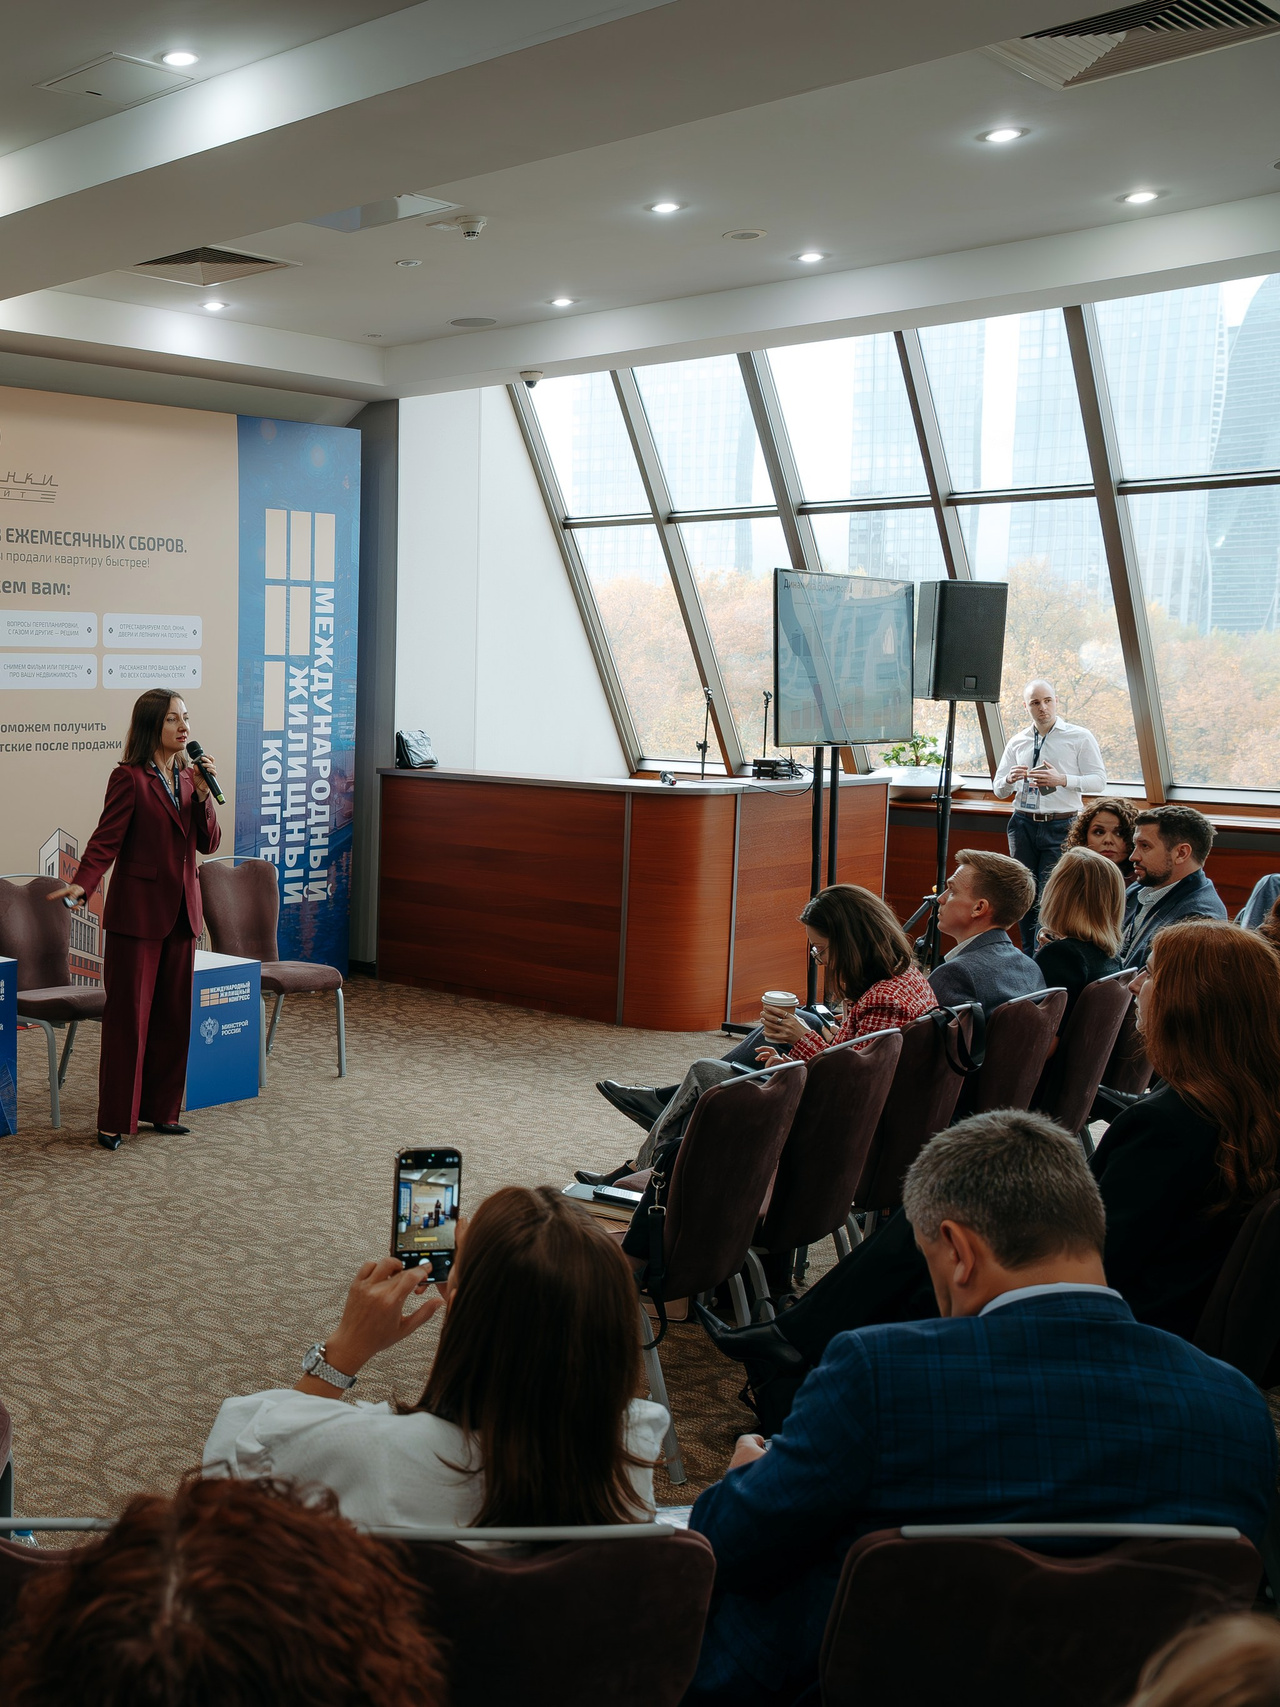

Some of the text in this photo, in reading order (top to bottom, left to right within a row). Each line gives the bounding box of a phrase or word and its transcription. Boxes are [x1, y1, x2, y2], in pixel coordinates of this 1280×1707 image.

[5, 528, 126, 550] ЕЖЕМЕСЯЧНЫХ
[129, 535, 188, 554] СБОРОВ.
[6, 552, 52, 565] продали
[54, 556, 104, 568] квартиру
[105, 555, 151, 570] быстрее!
[31, 580, 71, 596] вам:
[53, 722, 107, 735] получить
[35, 740, 69, 752] после
[71, 739, 122, 753] продажи
[307, 588, 334, 902] МЕЖДУНАРОДНЫЙ
[282, 664, 309, 905] ЖИЛИЩНЫЙ
[260, 739, 283, 880] КОНГРЕ
[210, 981, 250, 993] МЕЖДУНАРОДНЫЙ
[220, 987, 250, 997] ЖИЛИЩНЫЙ
[229, 994, 250, 1002] КОНГРЕСС
[222, 1020, 248, 1030] МИНСТРОЙ
[222, 1028, 241, 1036] РОССИИ
